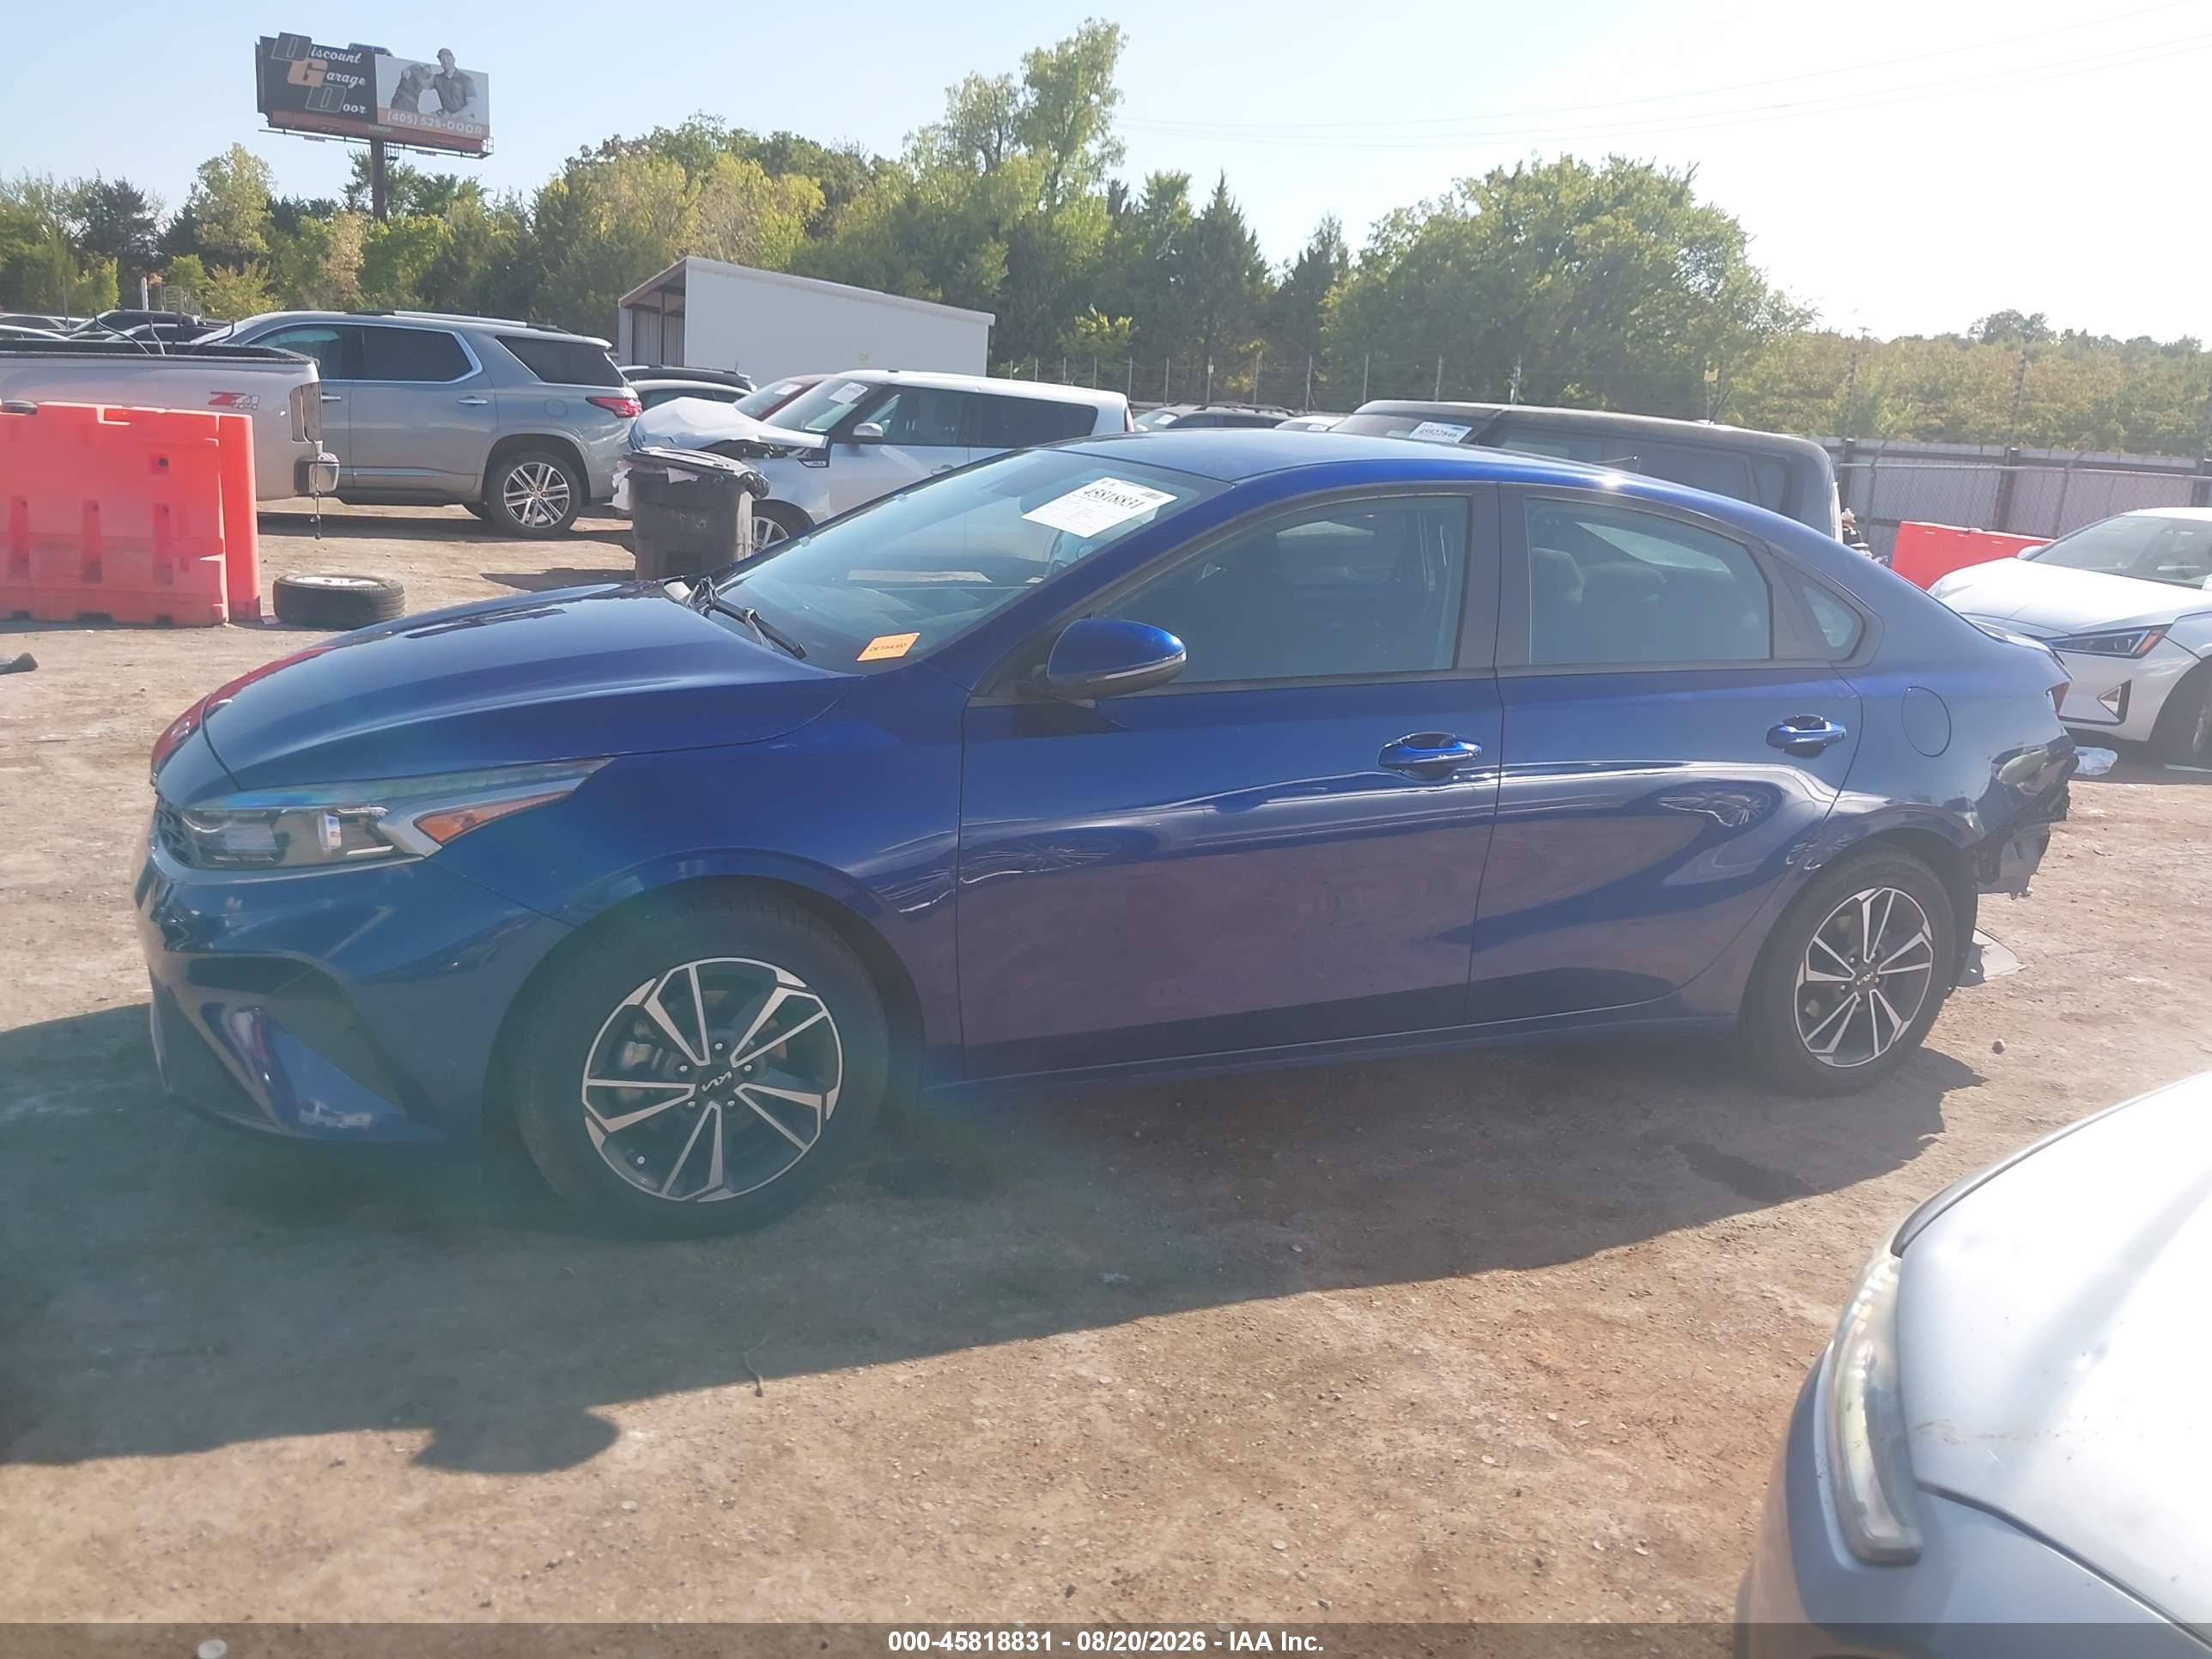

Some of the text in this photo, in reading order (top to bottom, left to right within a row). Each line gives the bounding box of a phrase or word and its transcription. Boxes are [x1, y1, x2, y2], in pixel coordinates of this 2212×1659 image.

[270, 32, 362, 64] Discount
[287, 58, 366, 89] Garage
[305, 83, 367, 114] Door
